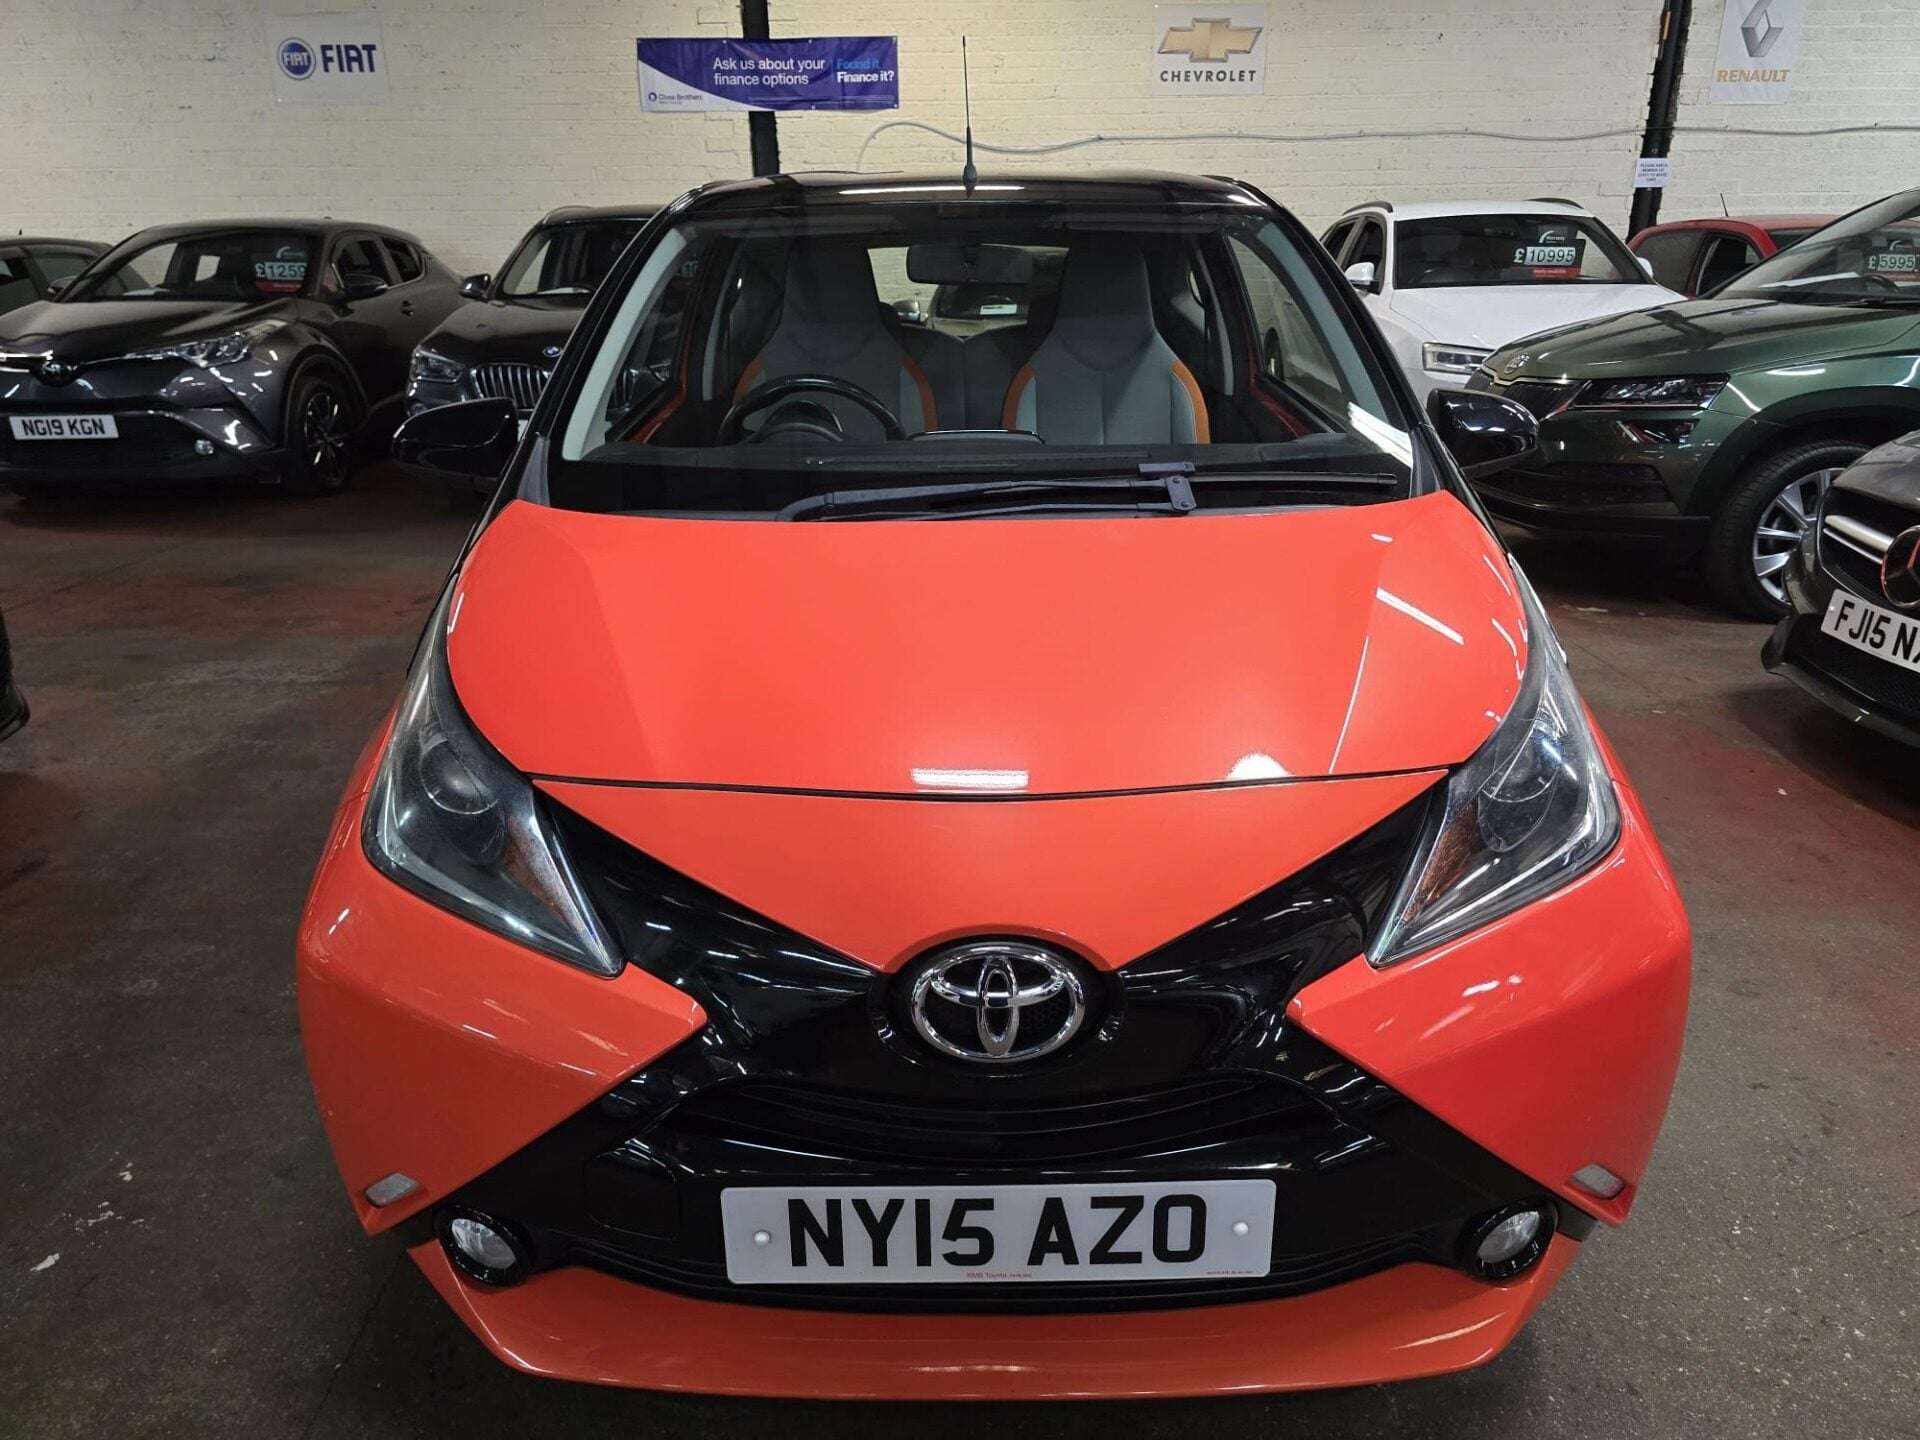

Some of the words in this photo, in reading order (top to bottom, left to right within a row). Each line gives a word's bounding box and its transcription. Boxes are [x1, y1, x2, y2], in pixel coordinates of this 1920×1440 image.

[282, 52, 309, 67] FIAT
[320, 44, 377, 73] FIAT
[713, 57, 738, 70] Ask
[740, 60, 755, 70] us
[758, 57, 795, 70] about
[798, 60, 826, 73] your
[713, 73, 759, 86] finance
[763, 72, 809, 88] options
[837, 71, 878, 83] Finance
[880, 70, 895, 82] it?
[1160, 70, 1257, 82] CHEVROLET
[1716, 69, 1790, 83] RENAULT
[21, 418, 64, 436] NG19
[66, 418, 106, 435] KGN
[1834, 599, 1892, 650] FJ15
[1892, 622, 1920, 665] N
[787, 1198, 995, 1267] NY15
[1027, 1193, 1208, 1266] AZO
